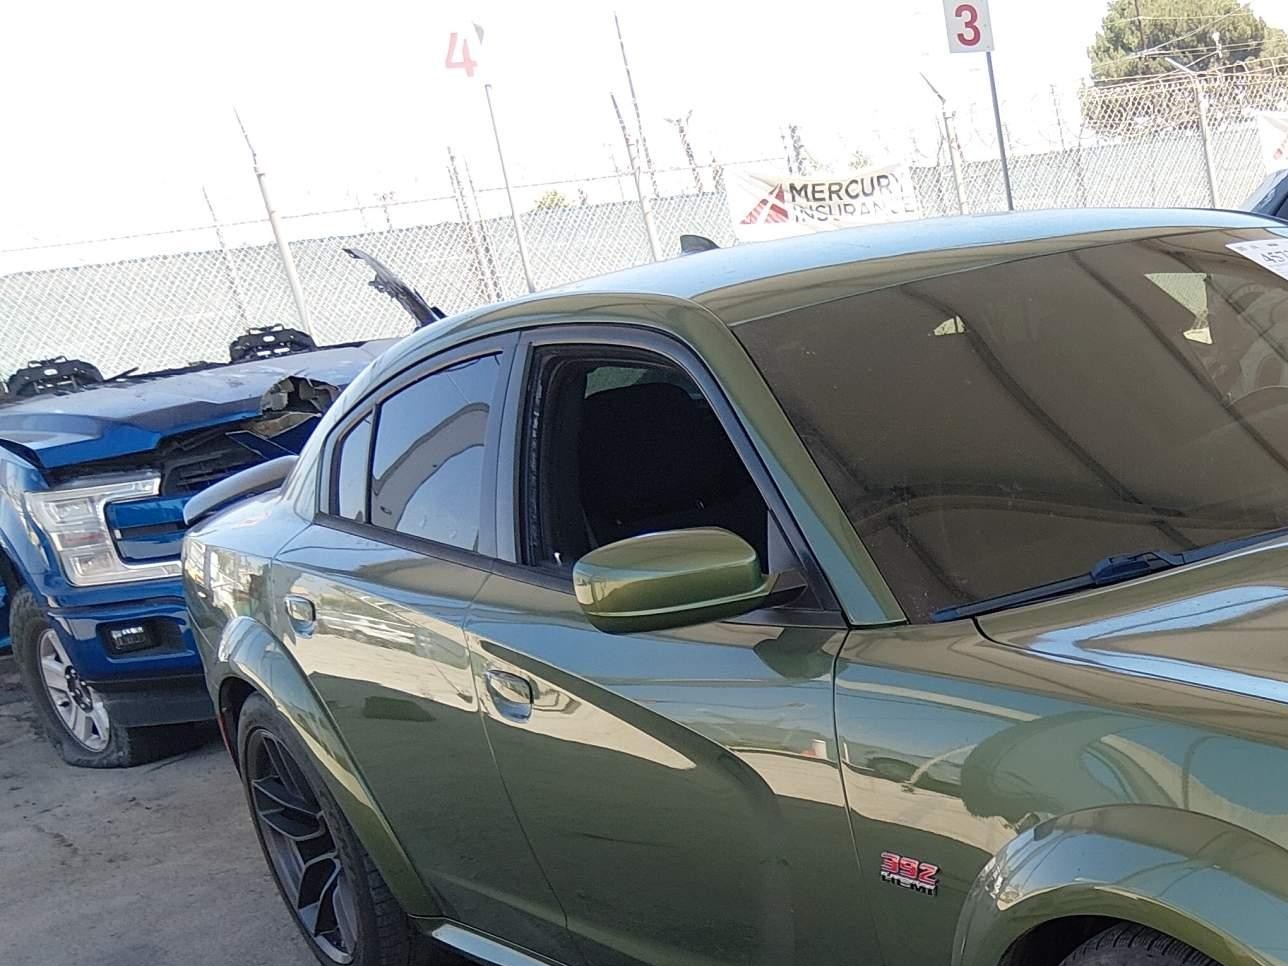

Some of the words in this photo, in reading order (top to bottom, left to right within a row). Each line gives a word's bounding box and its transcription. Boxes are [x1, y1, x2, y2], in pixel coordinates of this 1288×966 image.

[955, 4, 981, 46] 3
[445, 32, 478, 77] 4
[880, 851, 939, 888] 392
